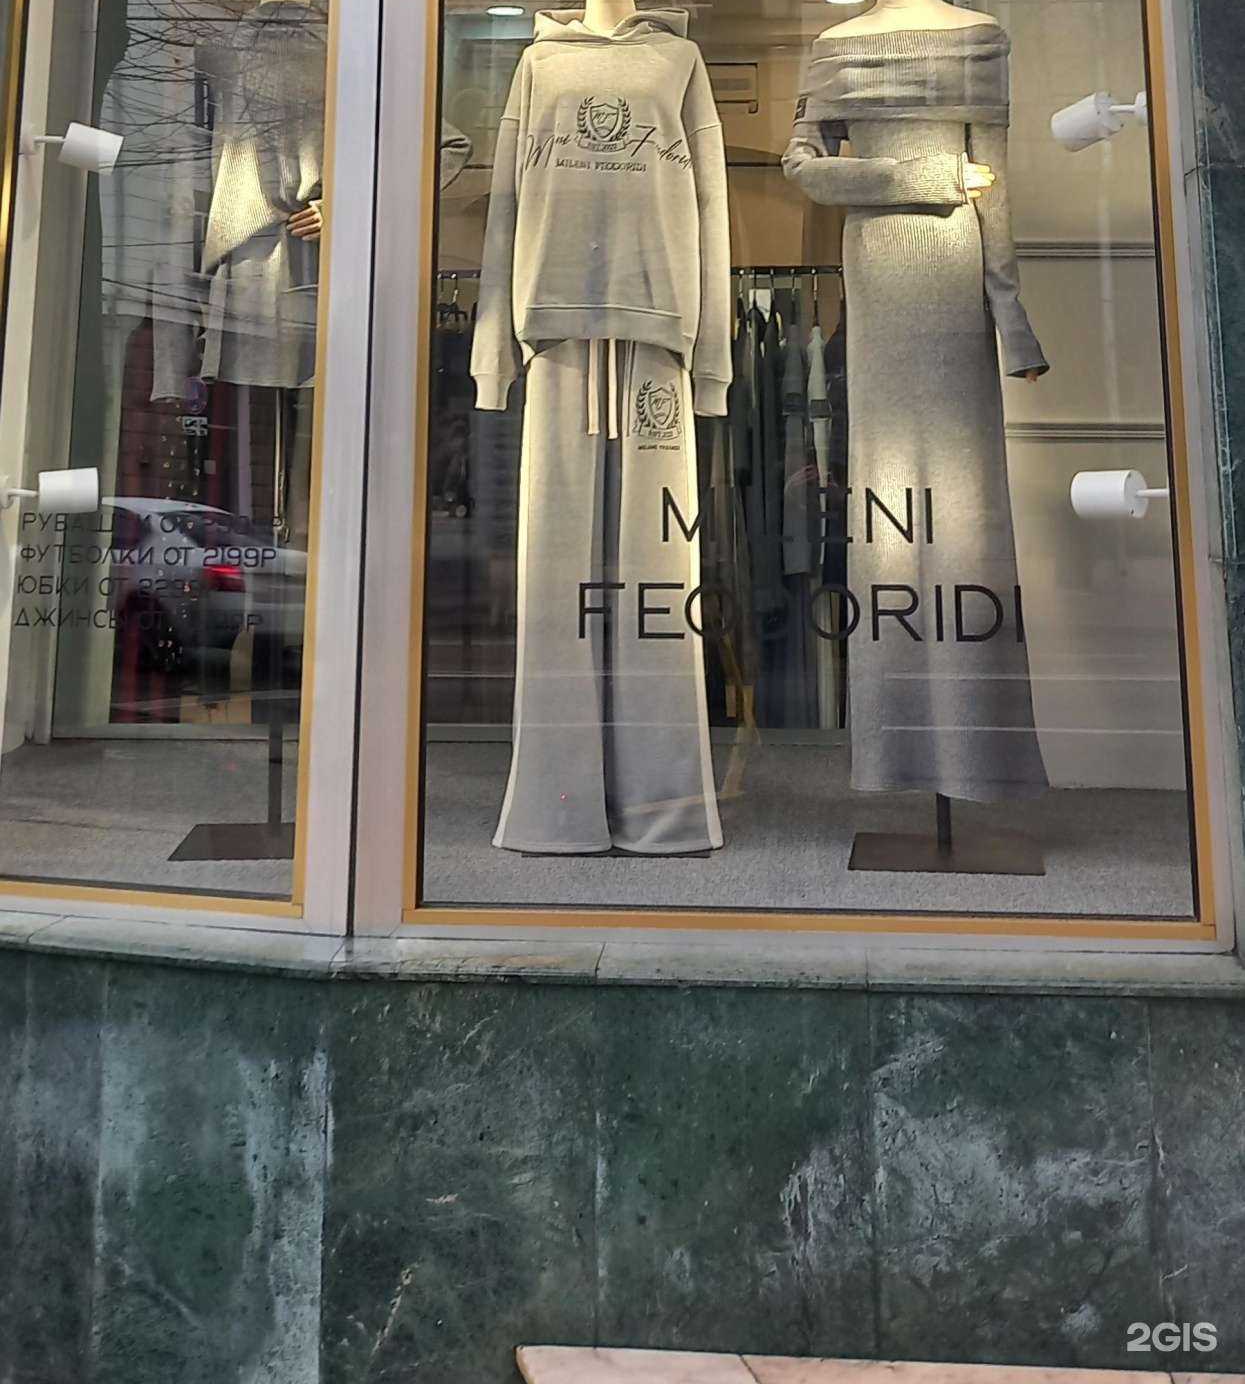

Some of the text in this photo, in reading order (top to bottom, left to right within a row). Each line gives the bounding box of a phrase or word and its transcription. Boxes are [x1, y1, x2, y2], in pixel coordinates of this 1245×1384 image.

[22, 512, 152, 533] РУБАШИ
[661, 486, 934, 544] MENI
[20, 545, 152, 566] ФУТБОЛКИ
[163, 546, 194, 567] ОТ
[17, 575, 89, 596] ЮБКИ
[98, 576, 128, 597] ОТ
[578, 581, 1025, 643] FEOORIDI
